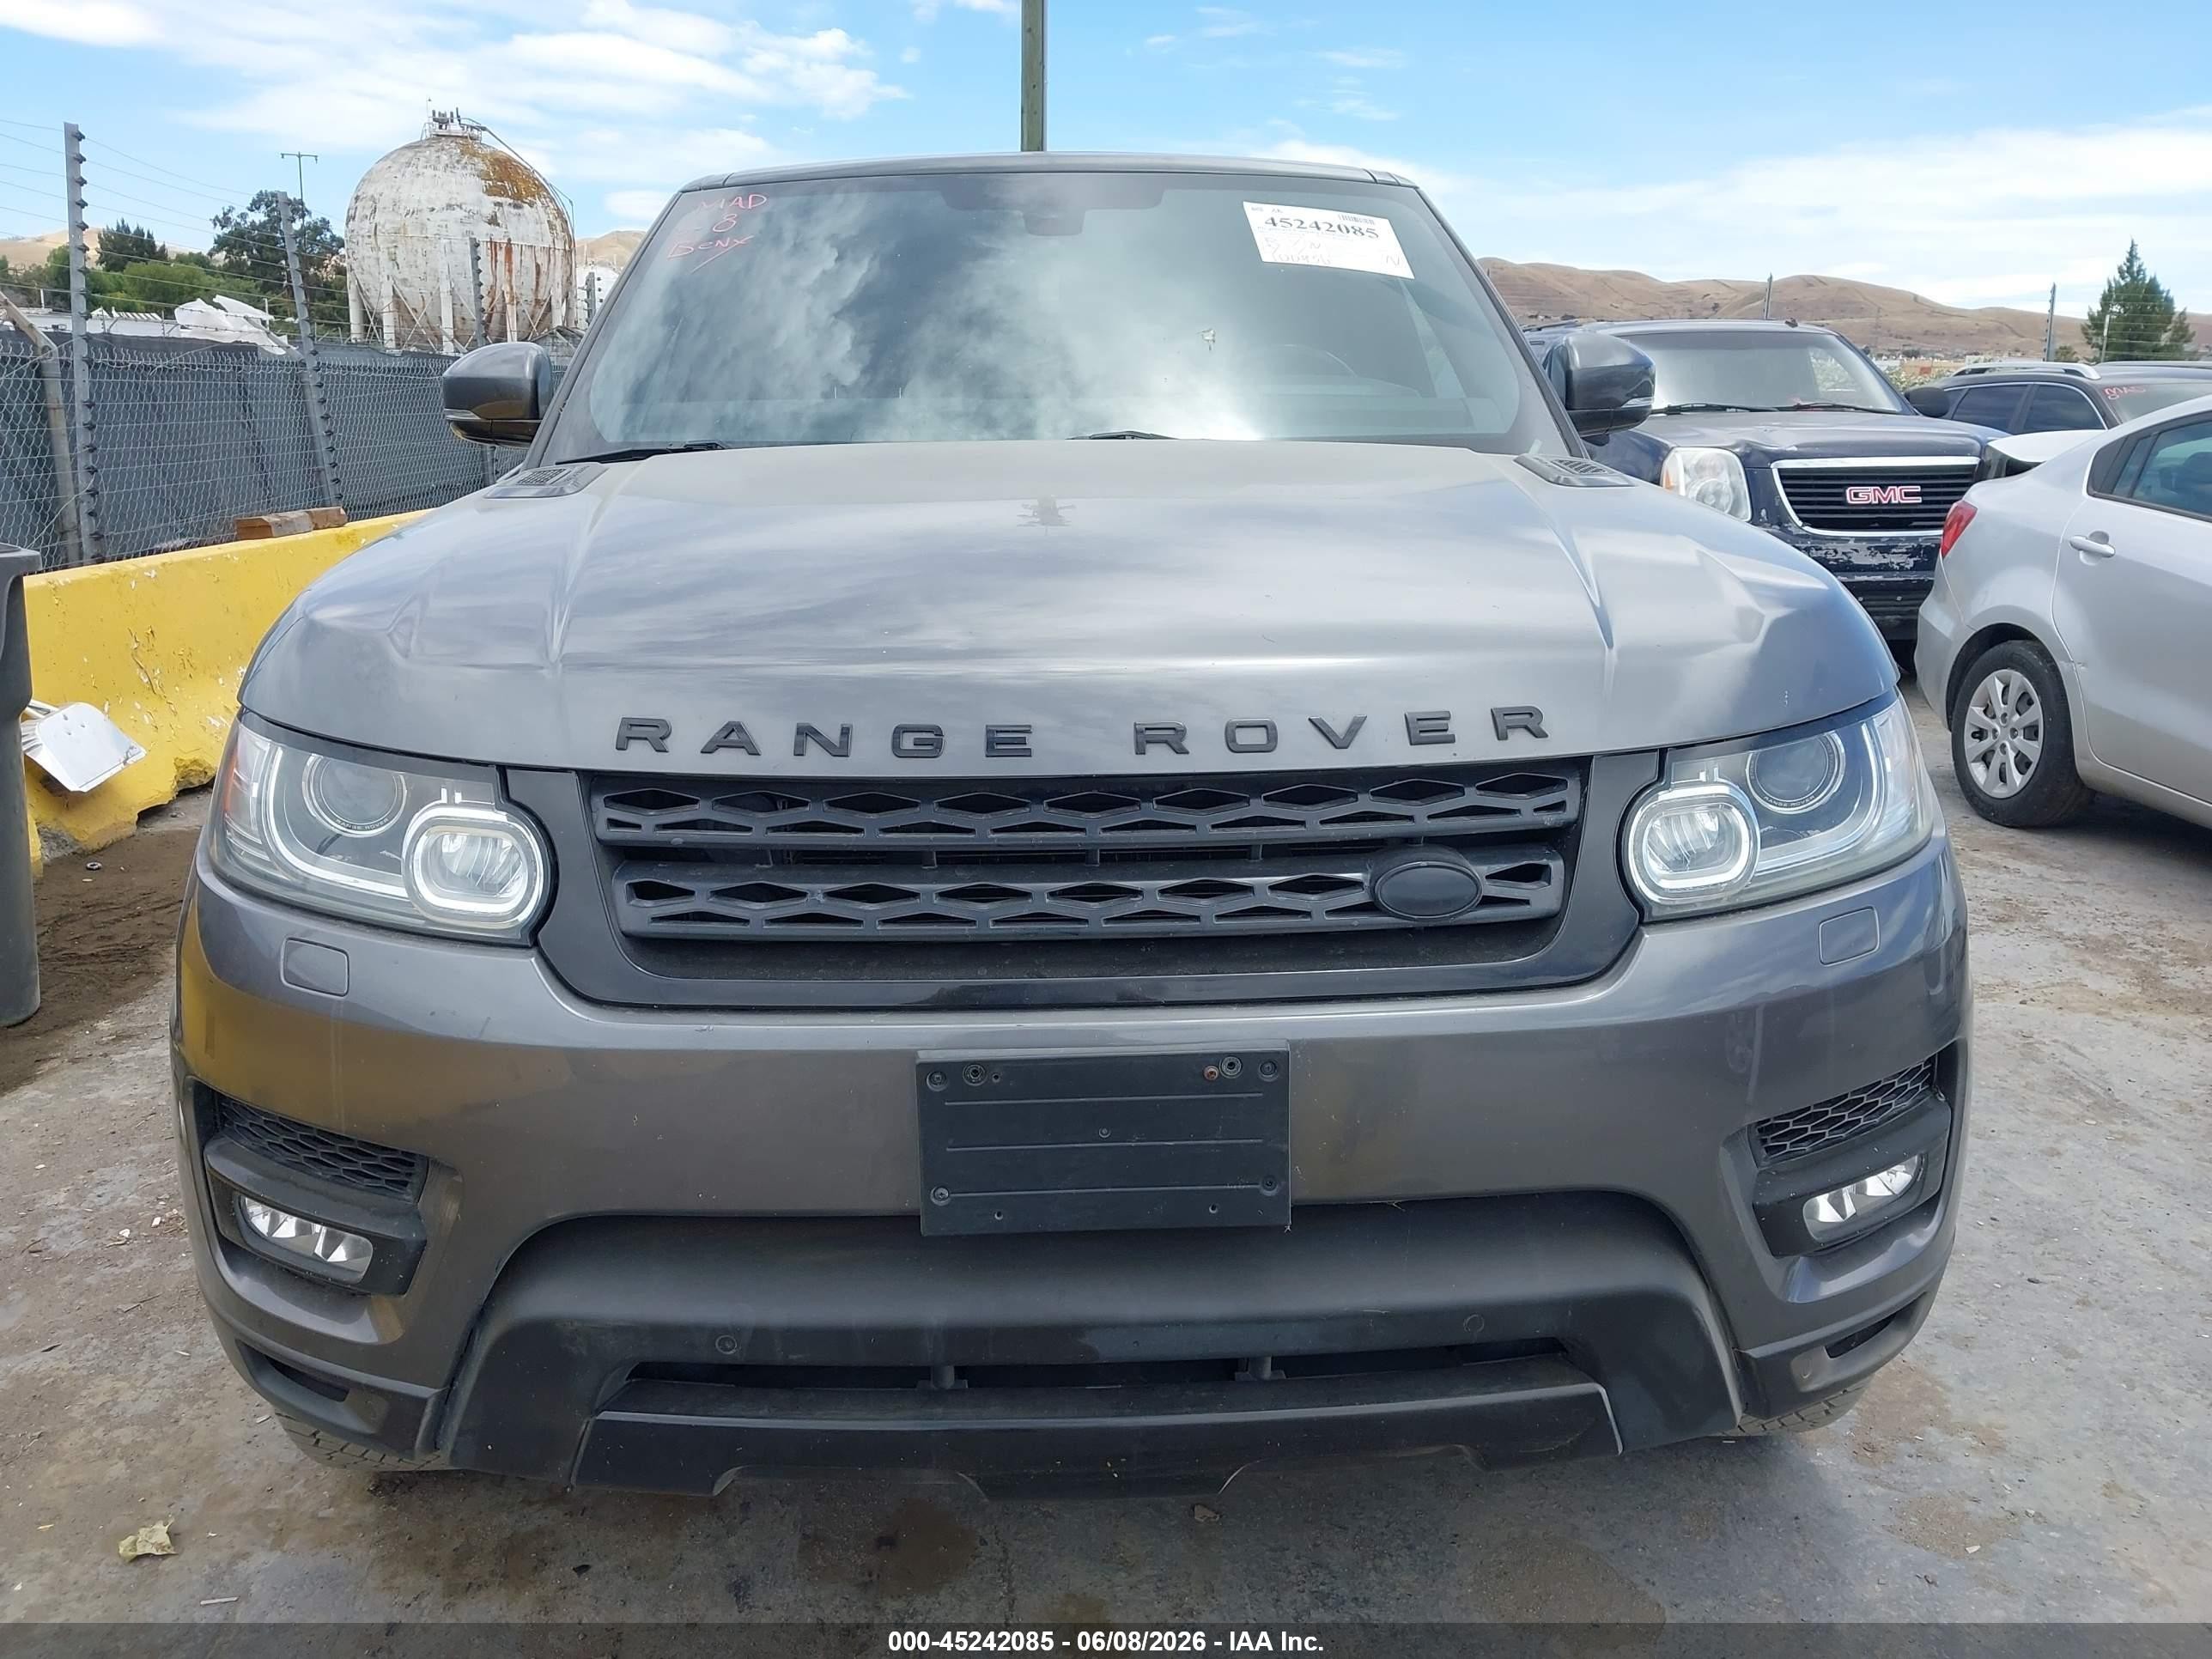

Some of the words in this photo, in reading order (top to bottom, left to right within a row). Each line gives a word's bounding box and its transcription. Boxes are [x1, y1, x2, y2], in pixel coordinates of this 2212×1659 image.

[1265, 216, 1379, 239] 45242085
[1846, 486, 1923, 504] GMC
[615, 717, 1033, 758] RANGE
[1133, 705, 1550, 756] ROVER
